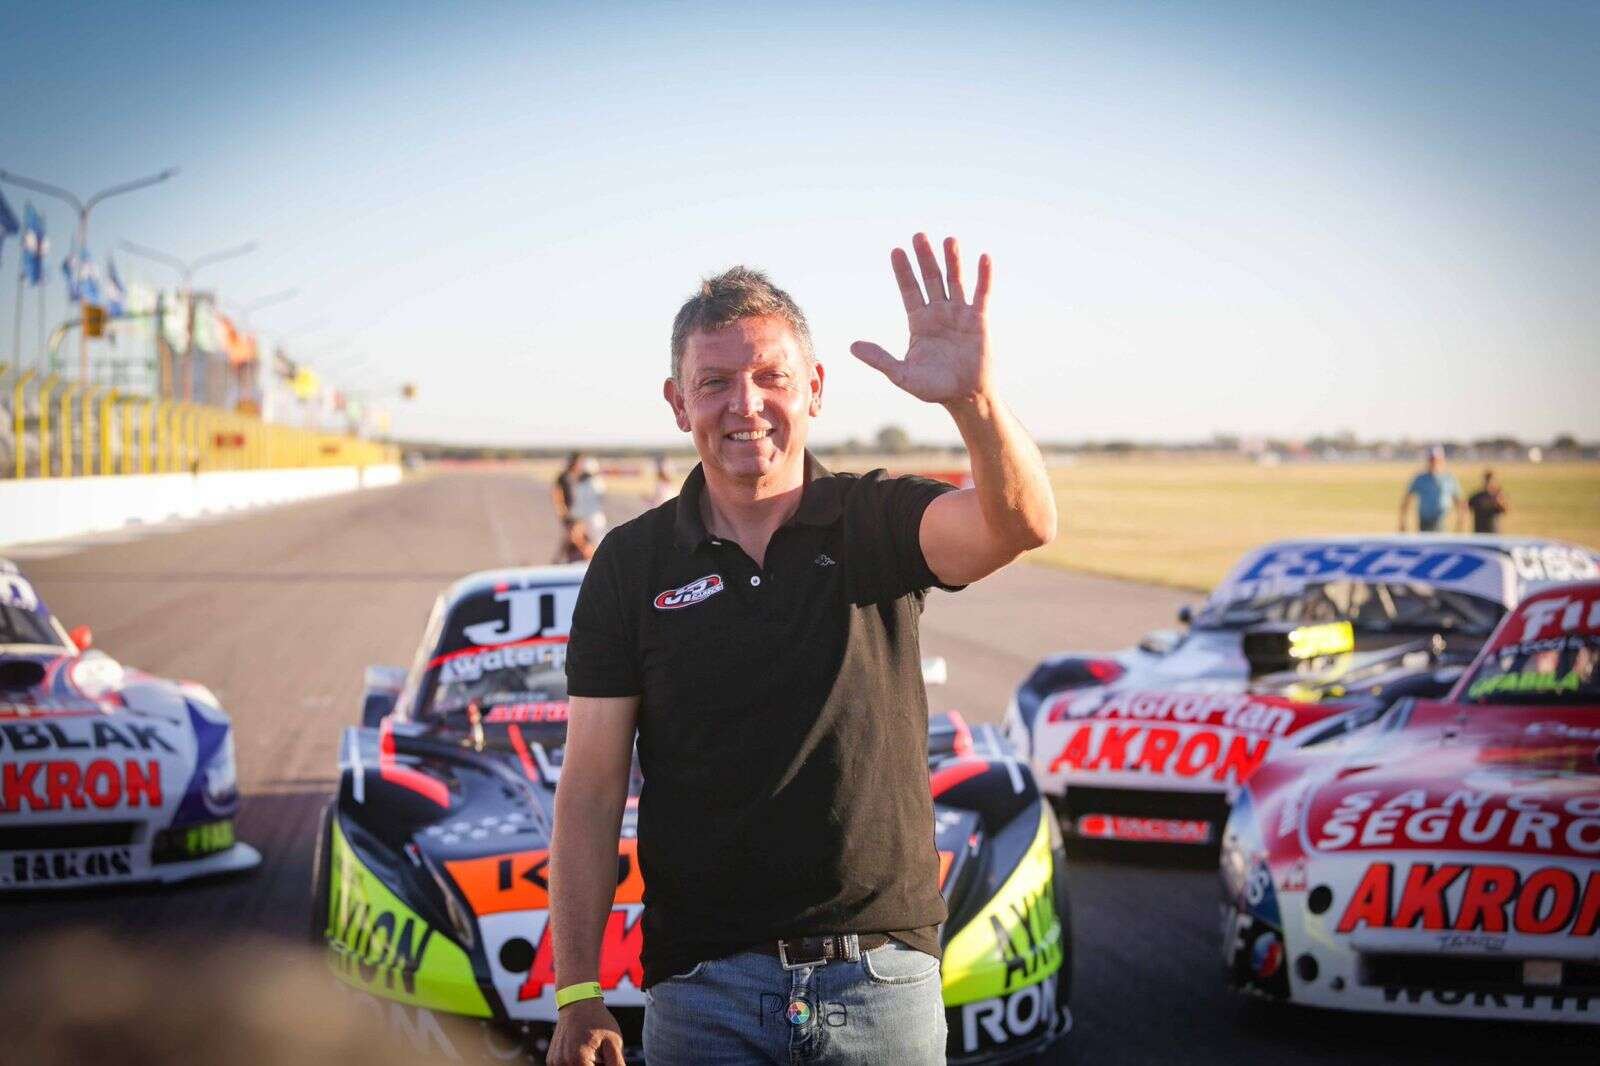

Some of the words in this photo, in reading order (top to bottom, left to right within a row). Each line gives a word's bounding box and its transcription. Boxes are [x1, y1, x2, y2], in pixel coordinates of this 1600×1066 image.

[0, 719, 181, 754] BLAK
[1048, 724, 1271, 786] AKRON
[0, 758, 164, 813] KRON
